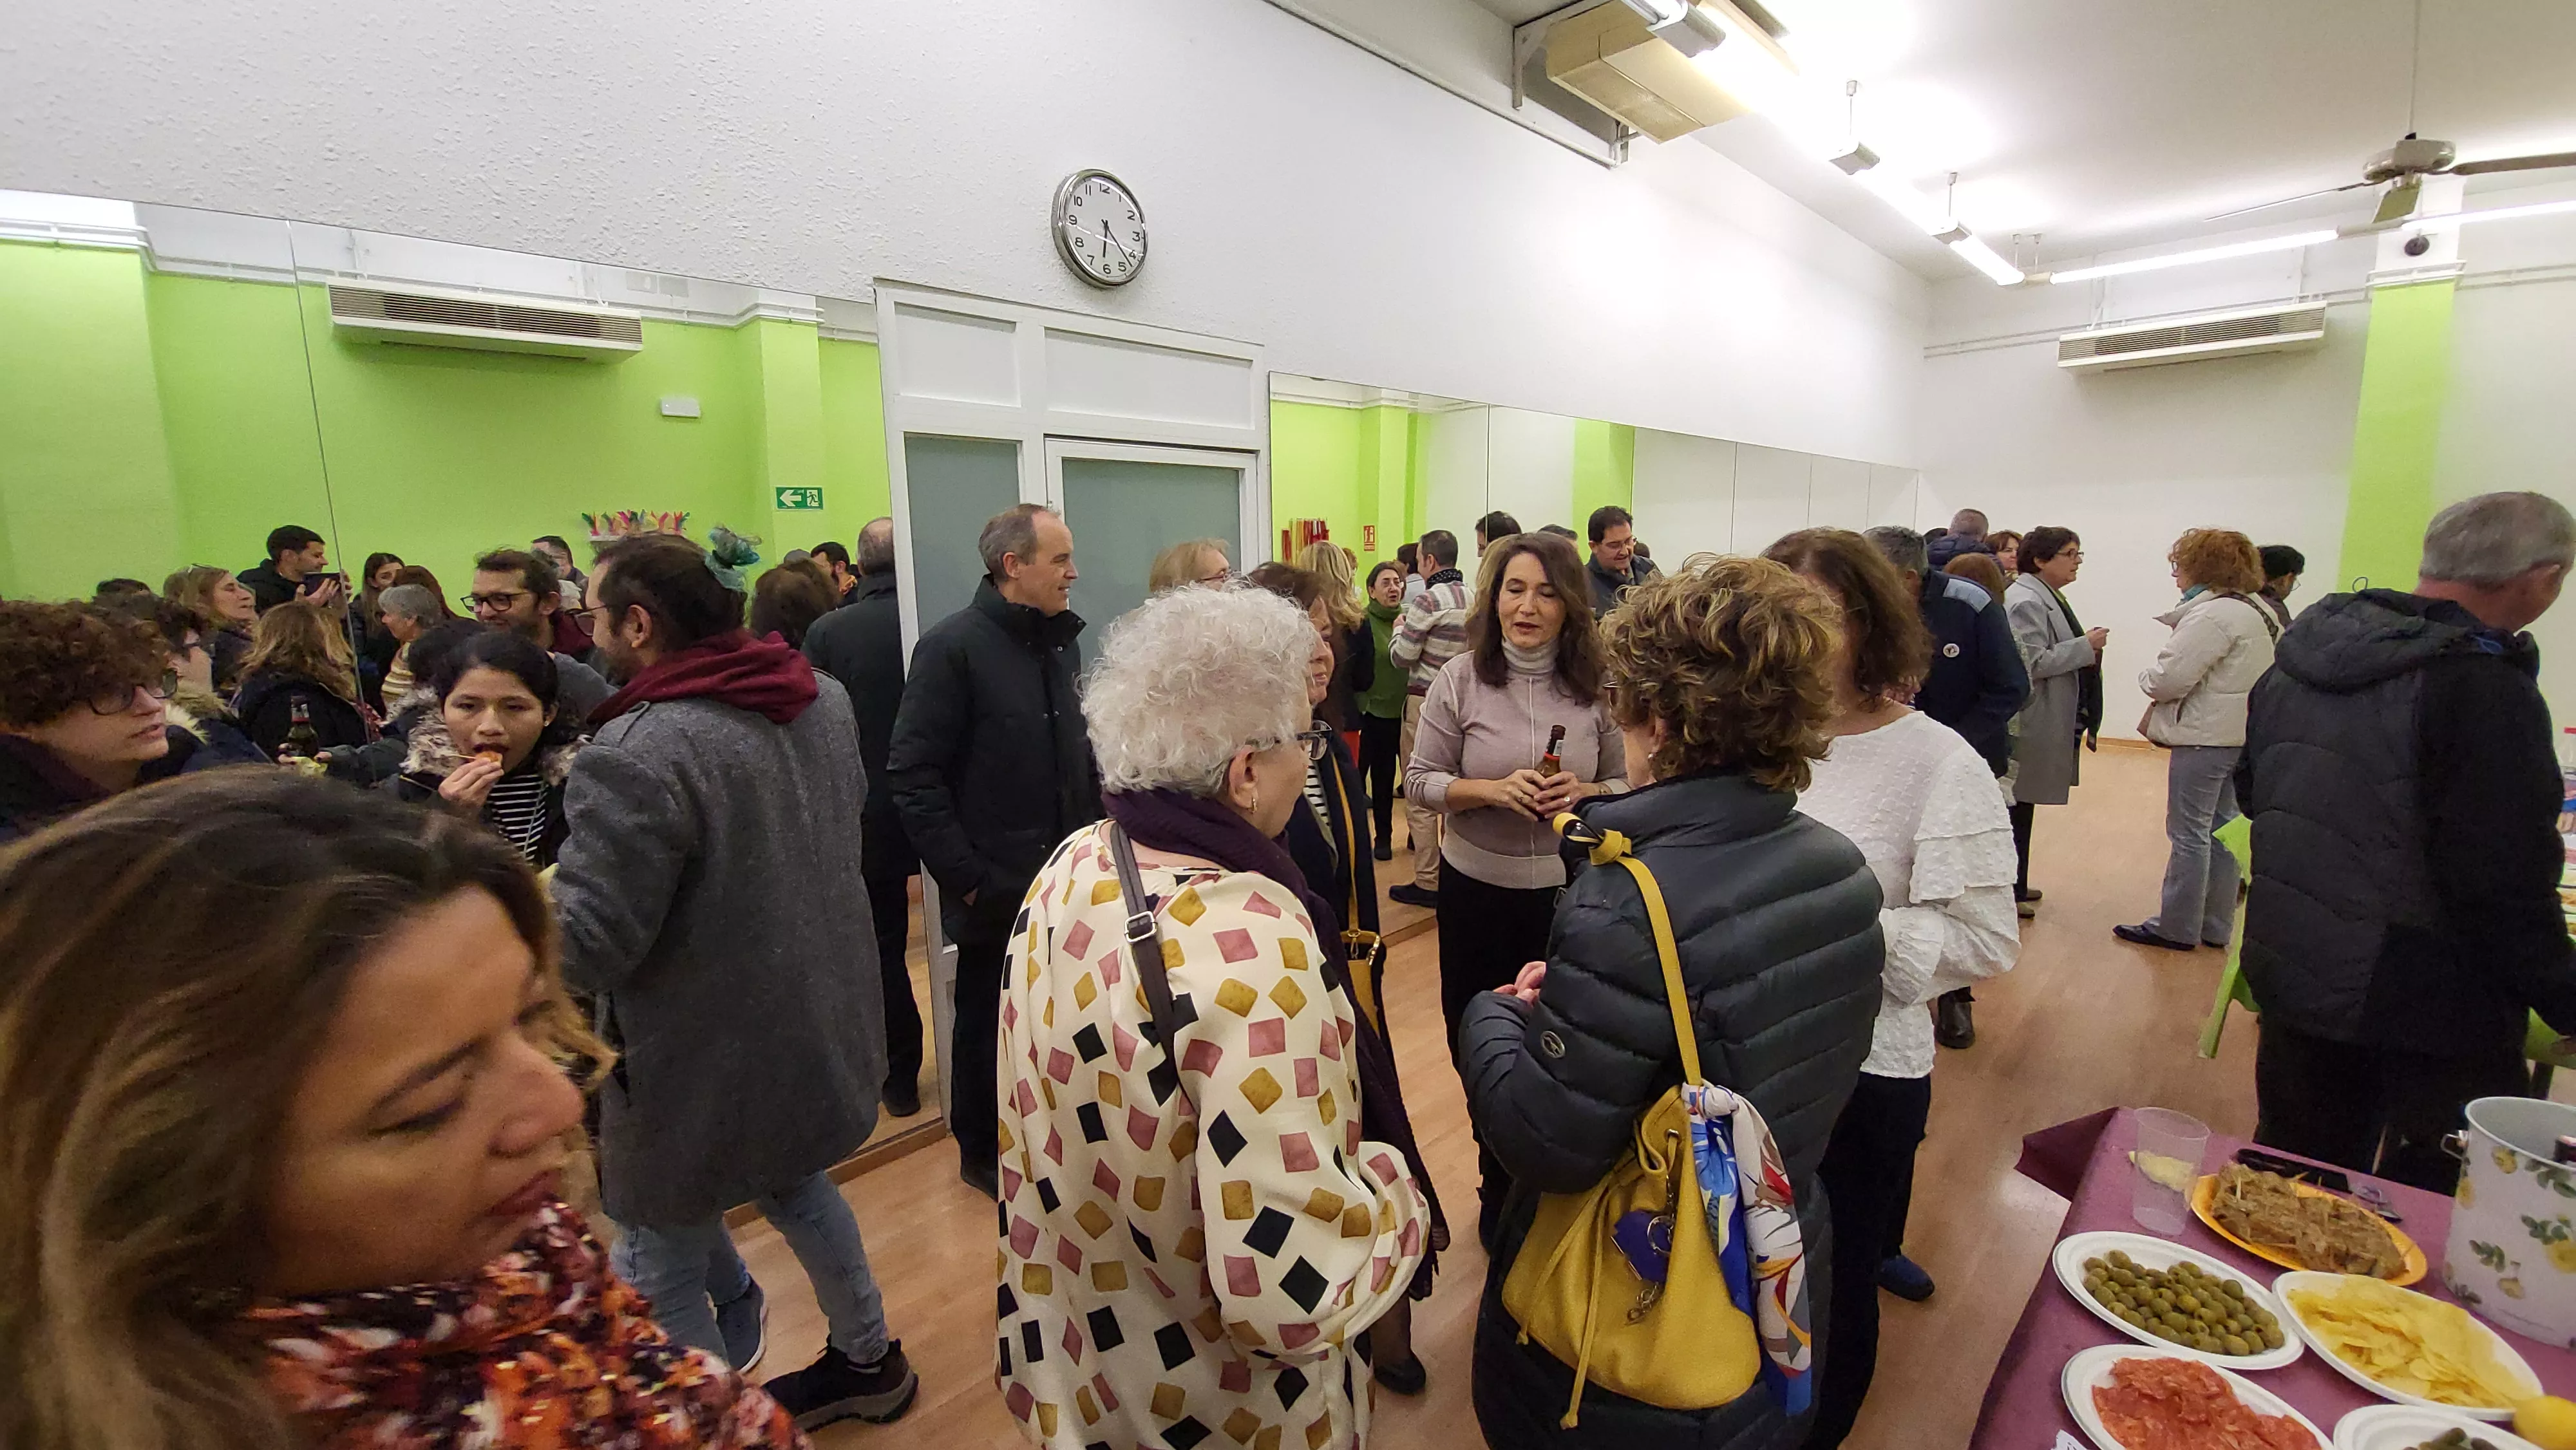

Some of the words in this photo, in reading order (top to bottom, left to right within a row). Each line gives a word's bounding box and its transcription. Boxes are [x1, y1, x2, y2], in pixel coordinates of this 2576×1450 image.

[1085, 184, 1092, 196] 11
[1099, 183, 1110, 194] 12
[1074, 195, 1083, 207] 10
[1119, 193, 1121, 202] 1
[1068, 214, 1077, 225] 9
[1127, 210, 1135, 221] 2
[1075, 237, 1084, 247] 8
[1132, 231, 1140, 242] 3
[1087, 254, 1095, 265] 7
[1129, 249, 1137, 259] 4
[1103, 264, 1111, 274] 6
[1118, 261, 1126, 272] 5
